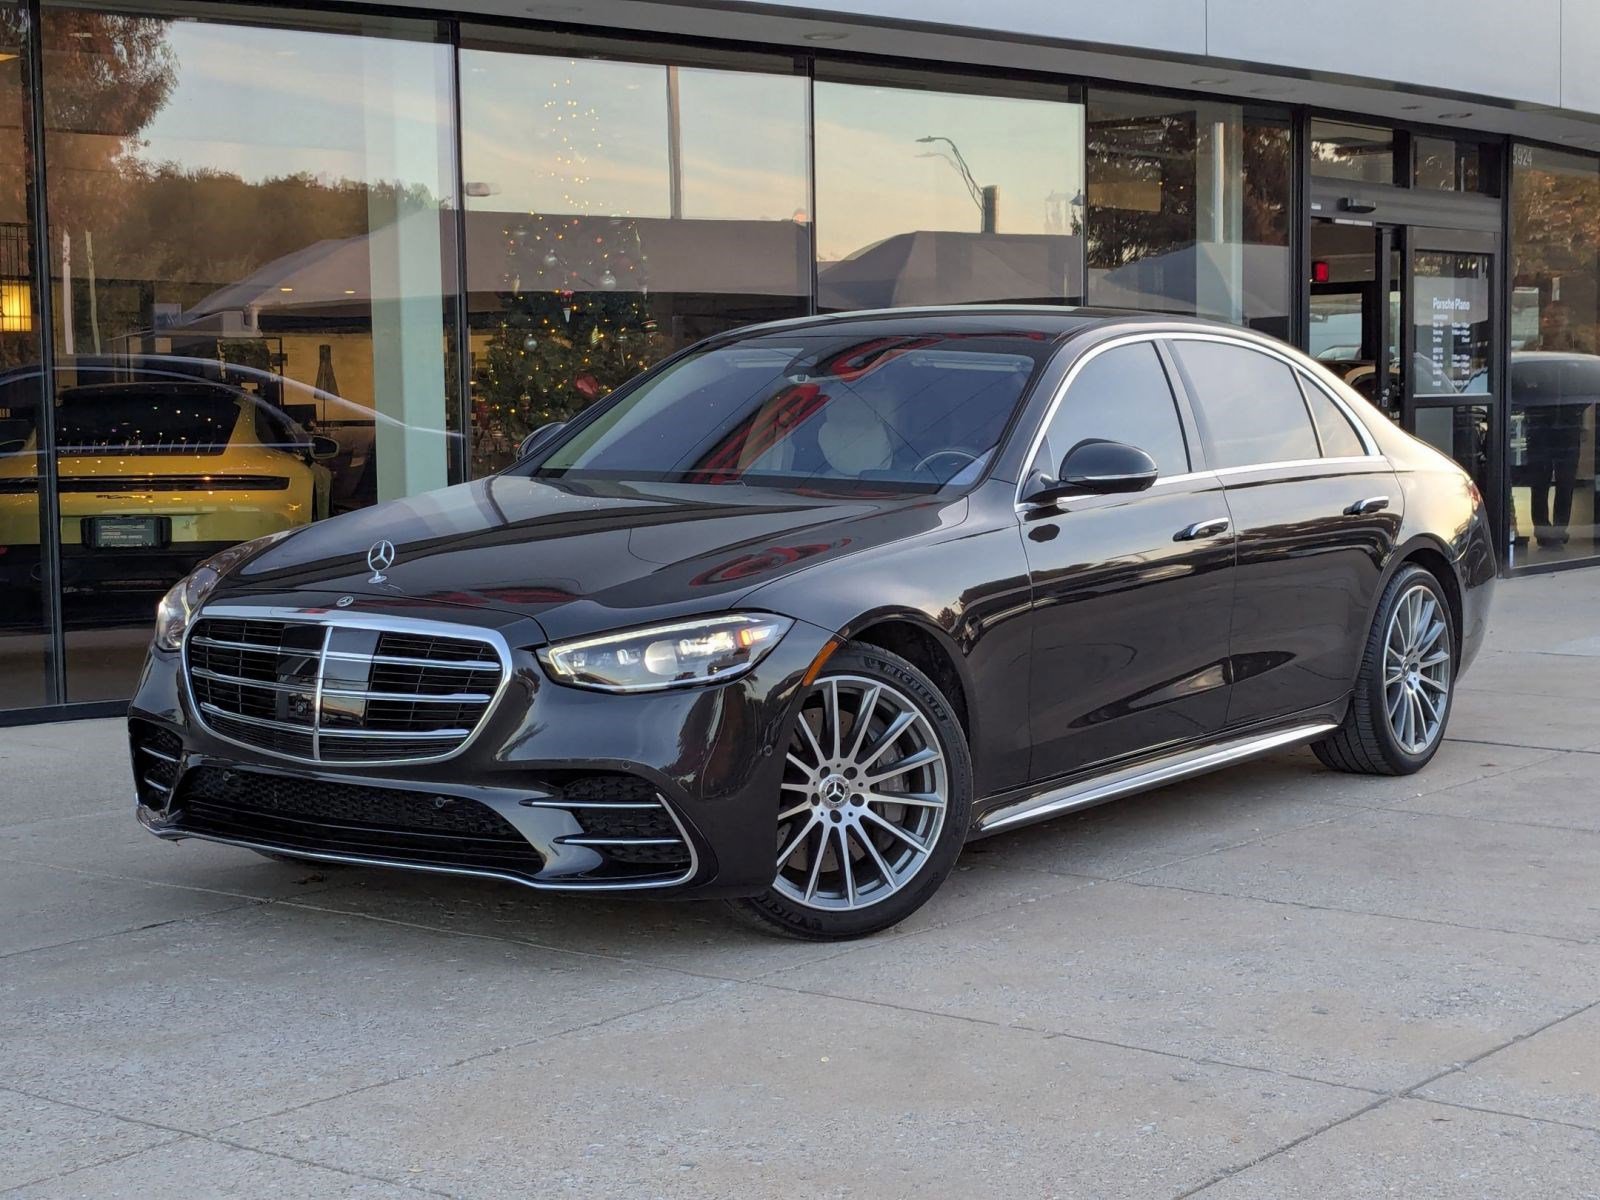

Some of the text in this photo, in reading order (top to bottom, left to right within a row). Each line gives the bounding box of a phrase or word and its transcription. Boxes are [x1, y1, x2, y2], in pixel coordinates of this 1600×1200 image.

[1432, 297, 1470, 311] Porsche Plano
[883, 661, 949, 722] MICHELIN
